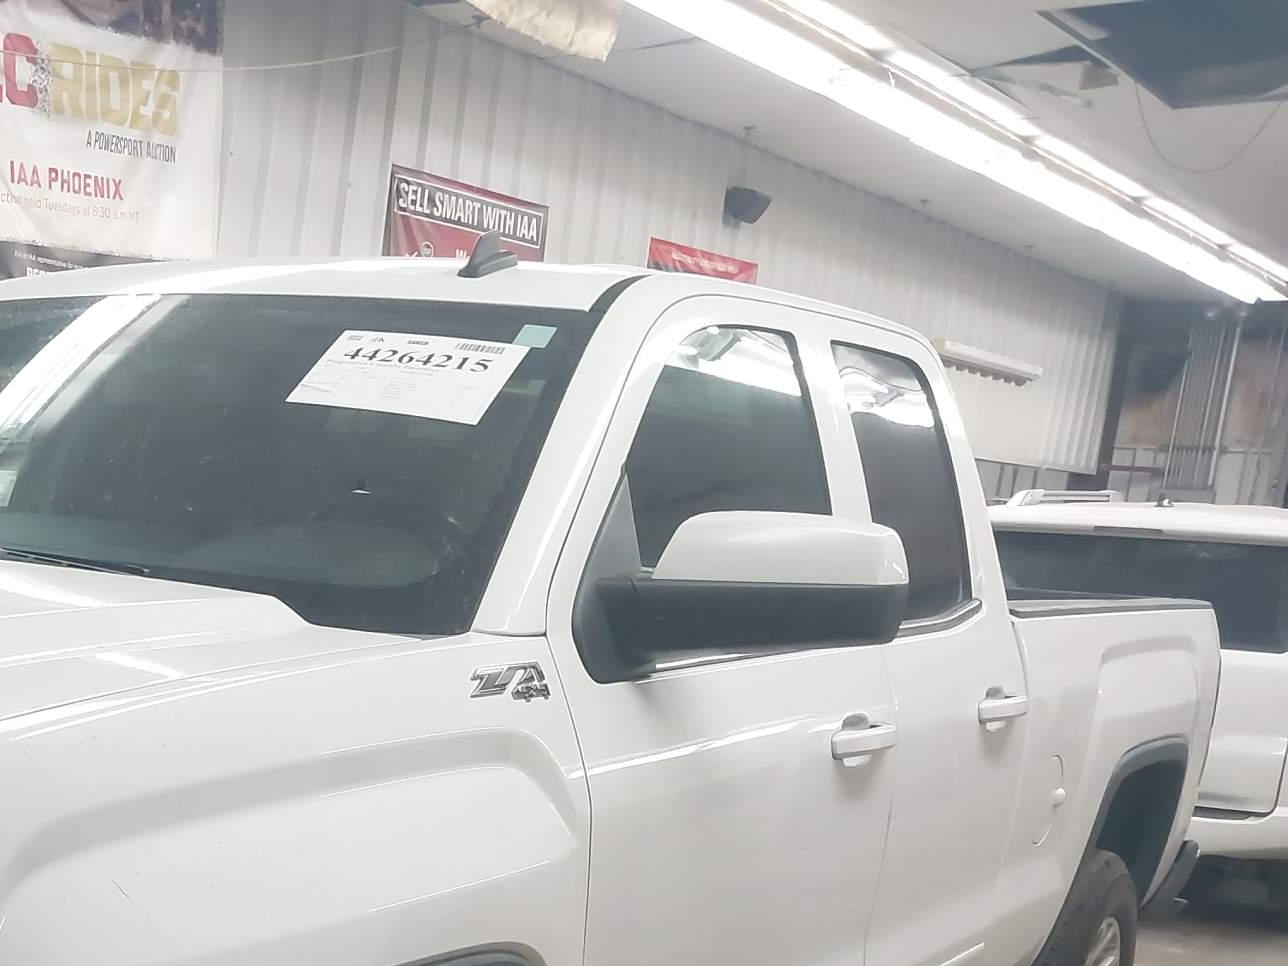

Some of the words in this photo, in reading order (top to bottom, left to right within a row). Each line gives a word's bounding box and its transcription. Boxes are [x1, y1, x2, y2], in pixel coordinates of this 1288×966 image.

[50, 42, 181, 136] RIDES
[86, 129, 92, 148] A
[93, 131, 144, 159] POWERSPORT
[146, 141, 176, 164] AUCTION
[9, 160, 42, 189] IAA
[48, 167, 124, 201] PHOENIX
[398, 182, 431, 214] SELL
[433, 191, 481, 226] SMART
[482, 204, 515, 235] WITH
[516, 215, 537, 242] IAA
[344, 347, 494, 373] 44264215
